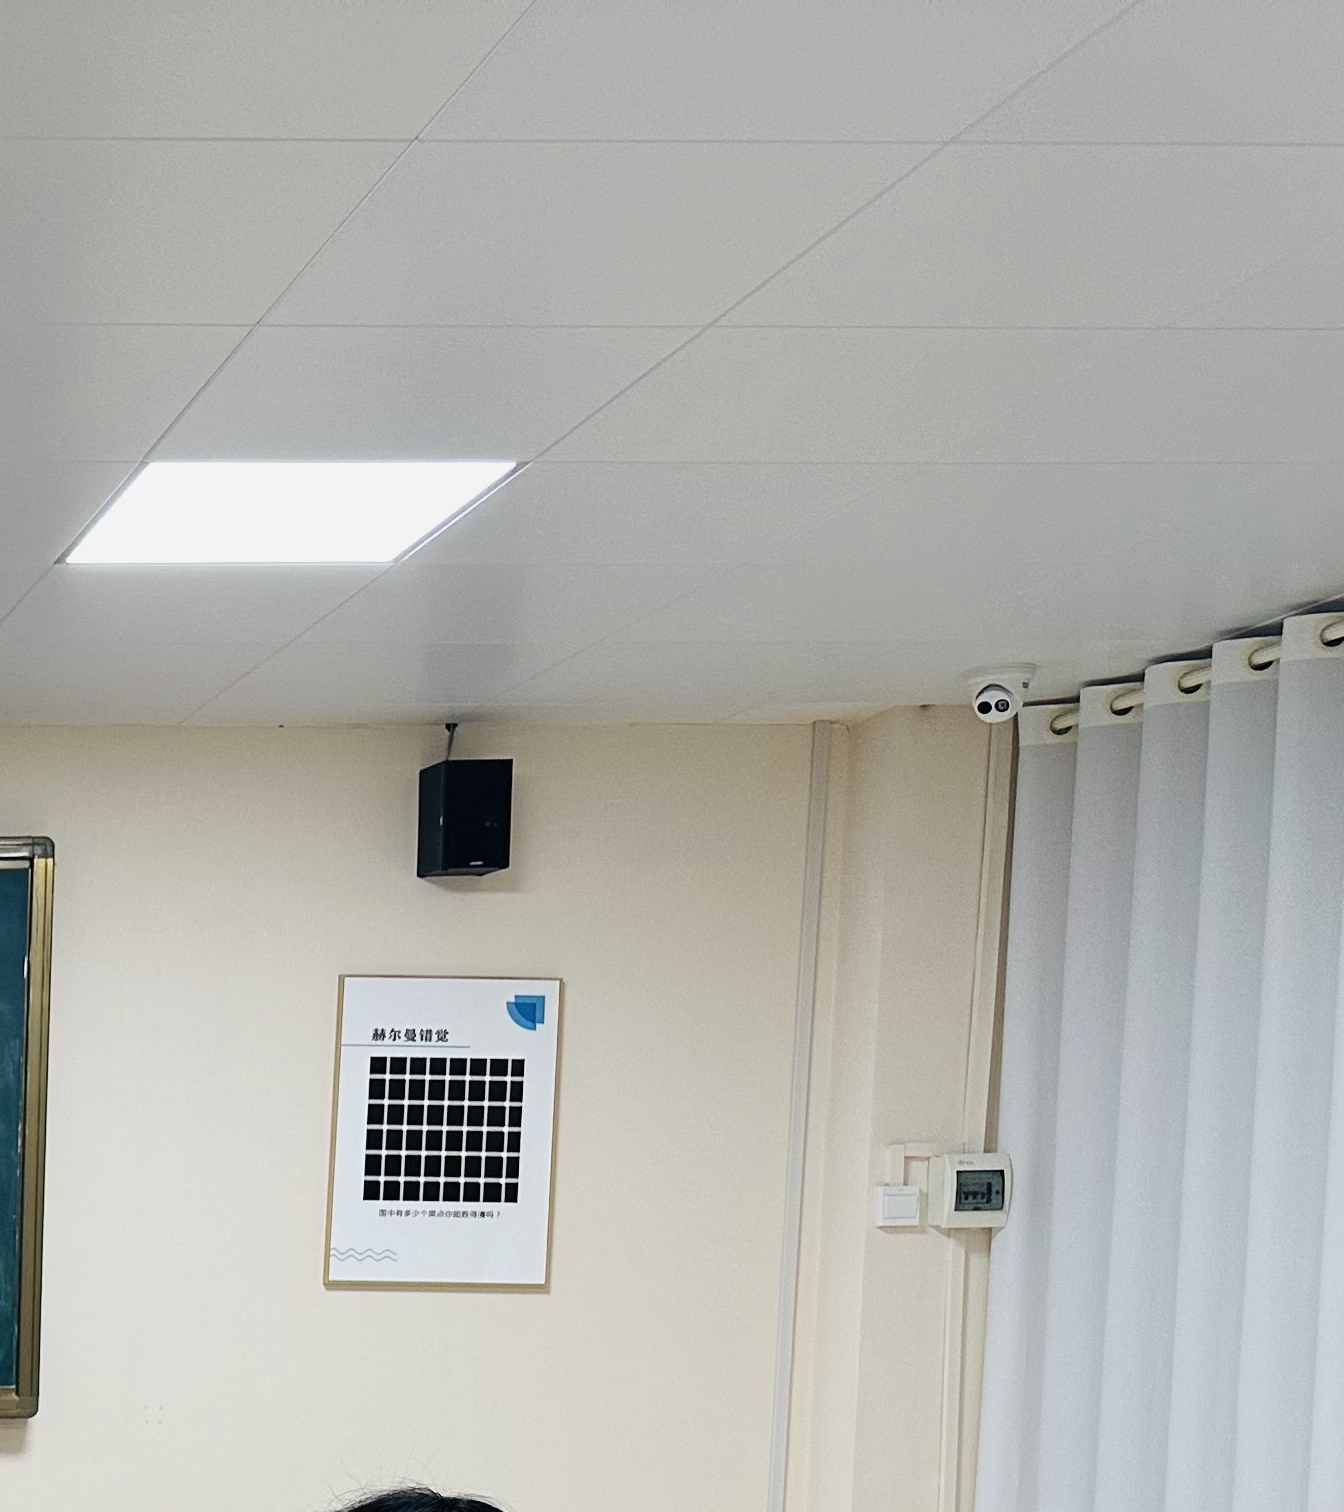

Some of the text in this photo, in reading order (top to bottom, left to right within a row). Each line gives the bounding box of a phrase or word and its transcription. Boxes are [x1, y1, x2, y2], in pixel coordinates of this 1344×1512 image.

[371, 1028, 449, 1043] 赫尔曼错觉
